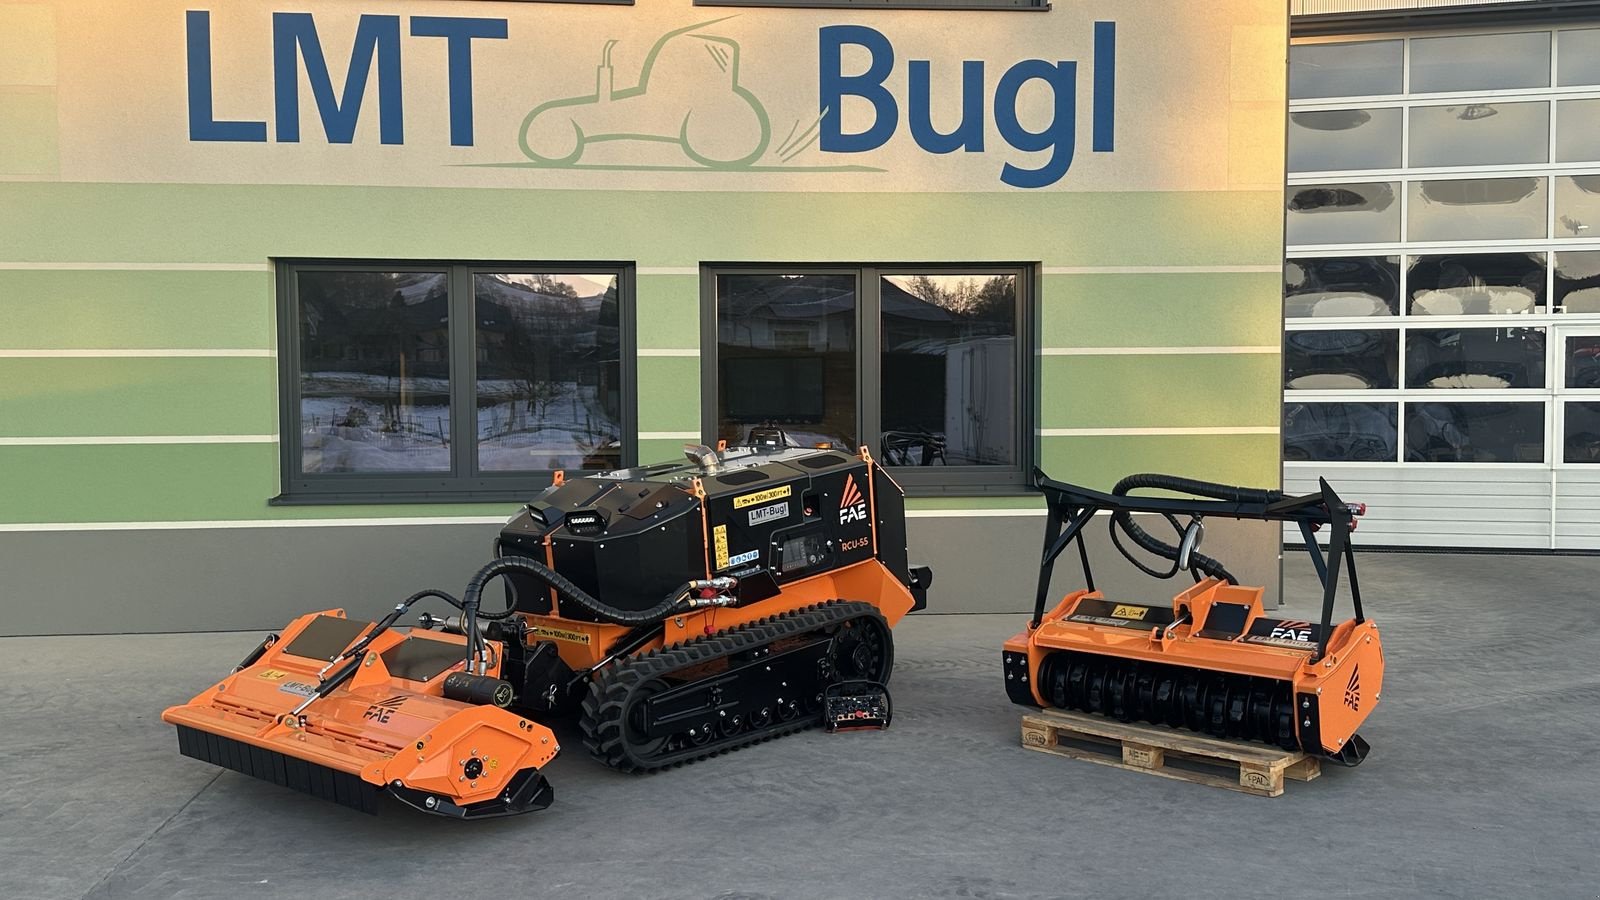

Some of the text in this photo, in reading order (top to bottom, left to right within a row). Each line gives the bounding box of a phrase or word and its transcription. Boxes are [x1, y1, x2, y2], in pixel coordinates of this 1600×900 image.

[188, 12, 1116, 189] LMT Bugl
[751, 504, 787, 520] LMT-Bugl
[839, 503, 867, 526] FAE
[841, 537, 869, 552] RCU-55
[1270, 627, 1312, 641] FAE
[284, 681, 316, 696] LMT-Bug
[1343, 691, 1360, 712] FAE
[363, 705, 395, 724] FAE
